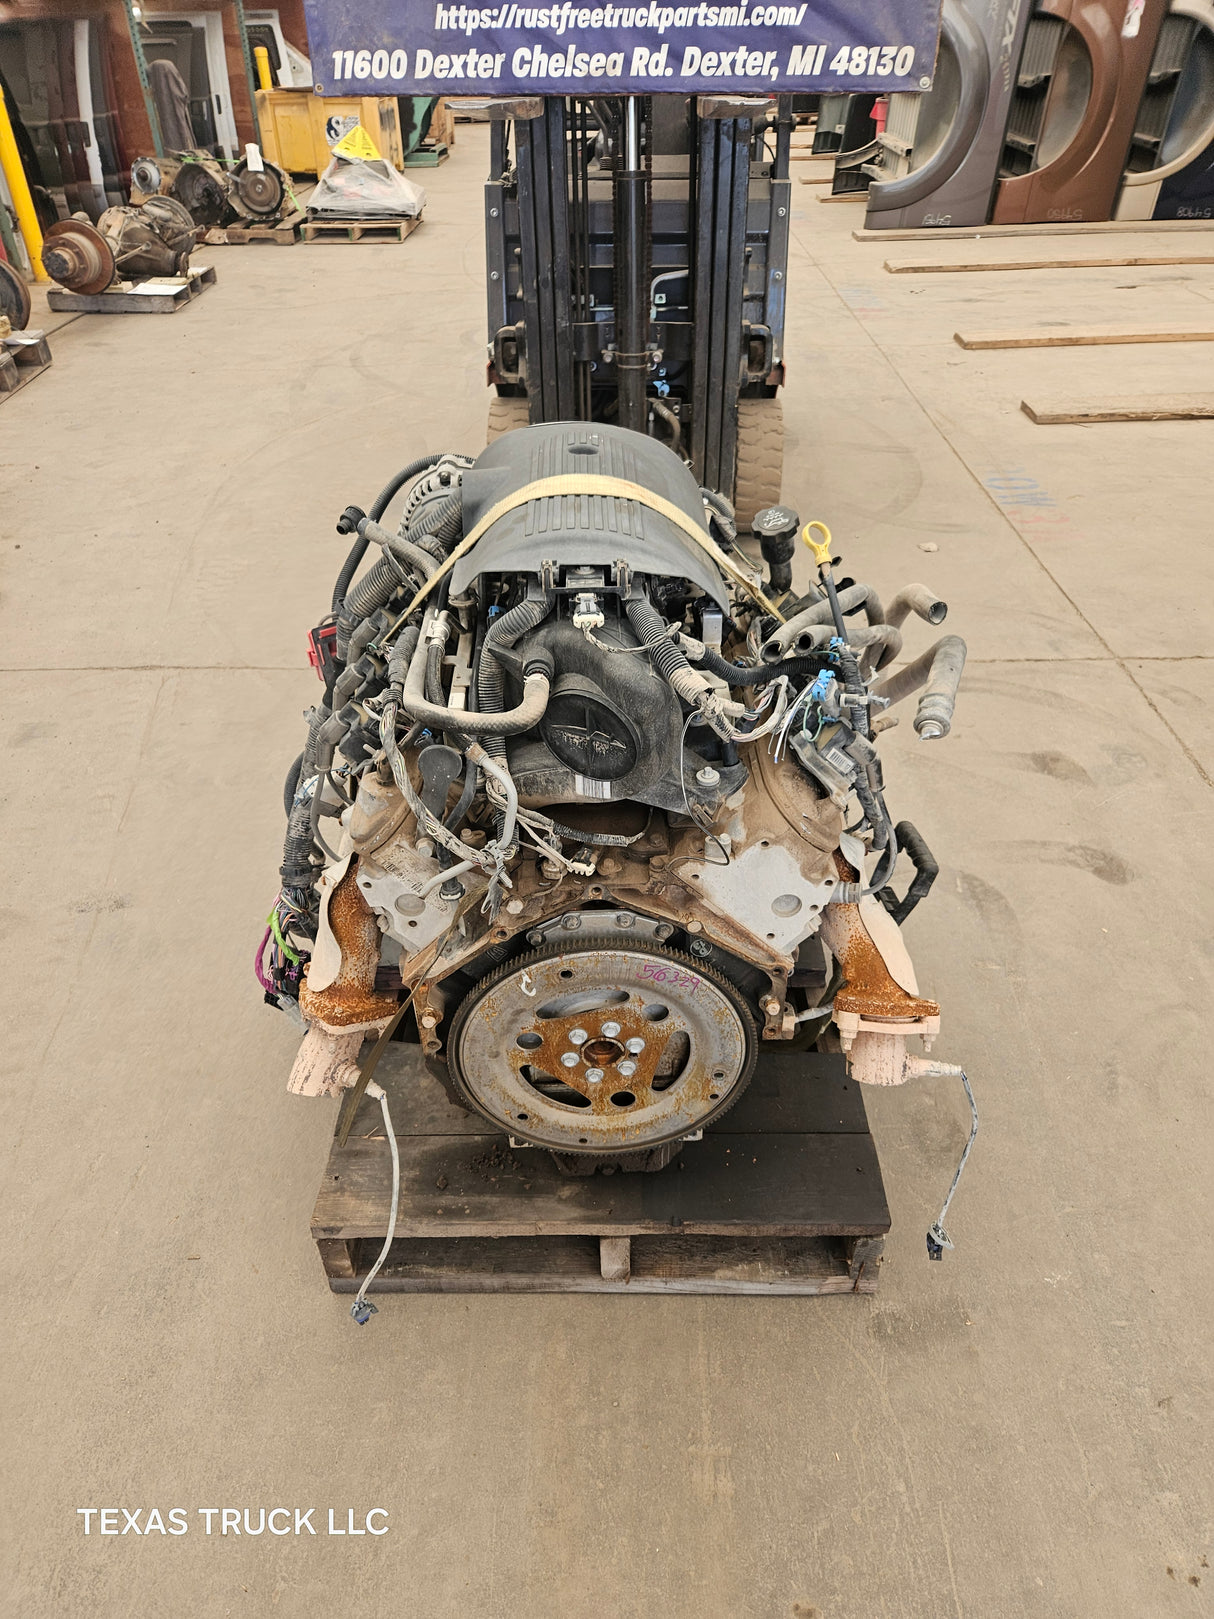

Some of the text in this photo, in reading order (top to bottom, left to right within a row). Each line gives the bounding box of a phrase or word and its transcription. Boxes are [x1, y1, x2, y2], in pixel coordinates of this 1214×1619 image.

[435, 0, 808, 36] https://rustfreetruckpartsmi.com/
[332, 44, 916, 81] 11600 Dexter Chelsea Rd. Dexter, MI 48130
[636, 964, 701, 996] 56329
